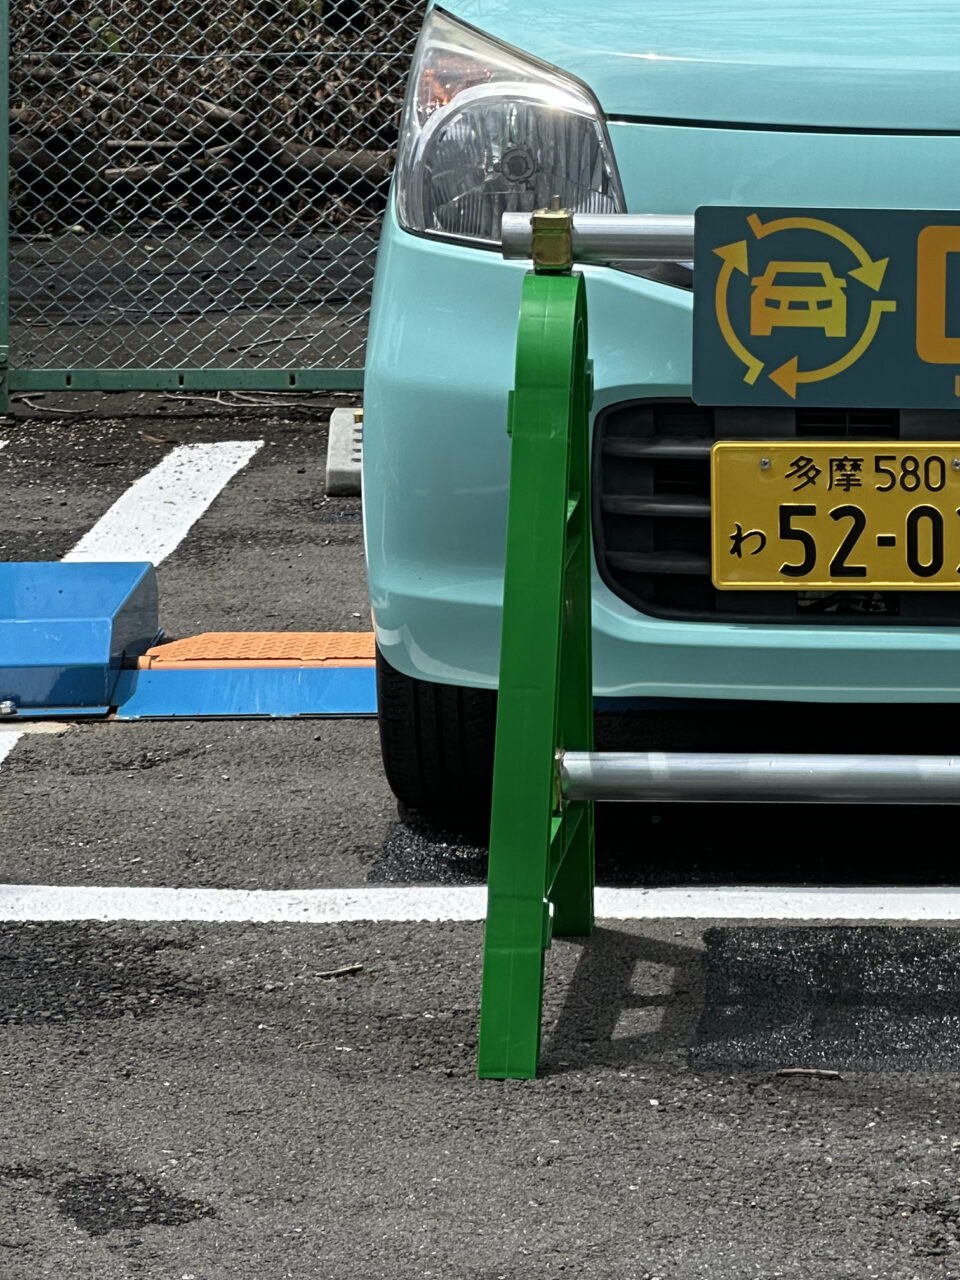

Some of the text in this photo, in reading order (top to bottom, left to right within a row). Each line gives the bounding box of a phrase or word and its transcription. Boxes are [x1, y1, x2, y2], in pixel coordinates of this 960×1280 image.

[783, 455, 947, 493] 多摩 580
[729, 523, 767, 559] わ
